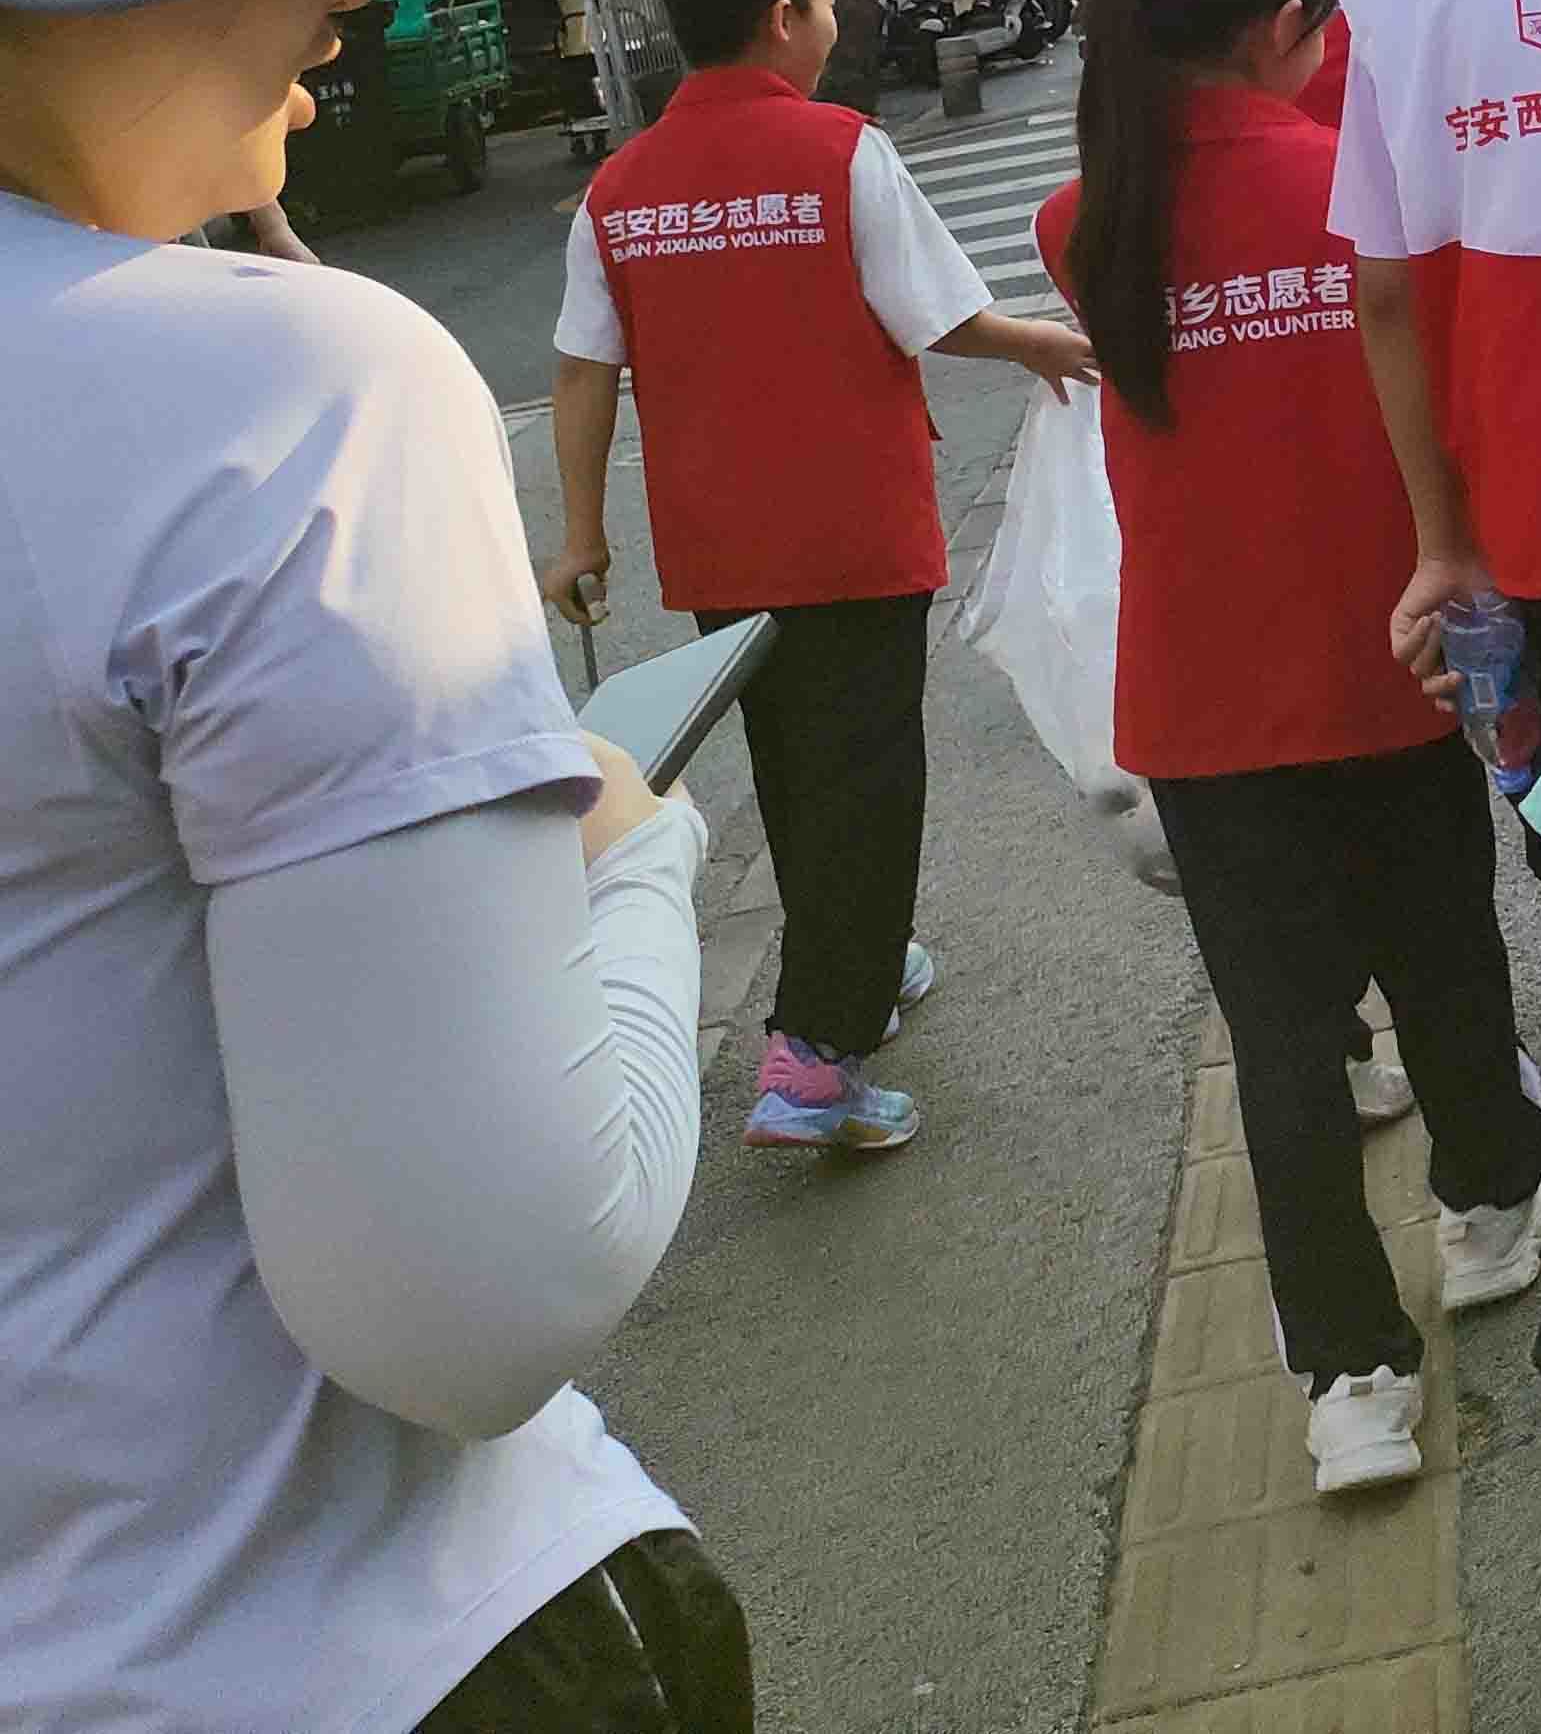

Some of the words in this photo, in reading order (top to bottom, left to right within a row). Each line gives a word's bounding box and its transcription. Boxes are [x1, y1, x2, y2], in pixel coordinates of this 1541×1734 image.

[654, 233, 728, 257] XIXIANG
[730, 227, 827, 249] VOLUNTEER
[1230, 309, 1356, 343] VOLUNTEER
